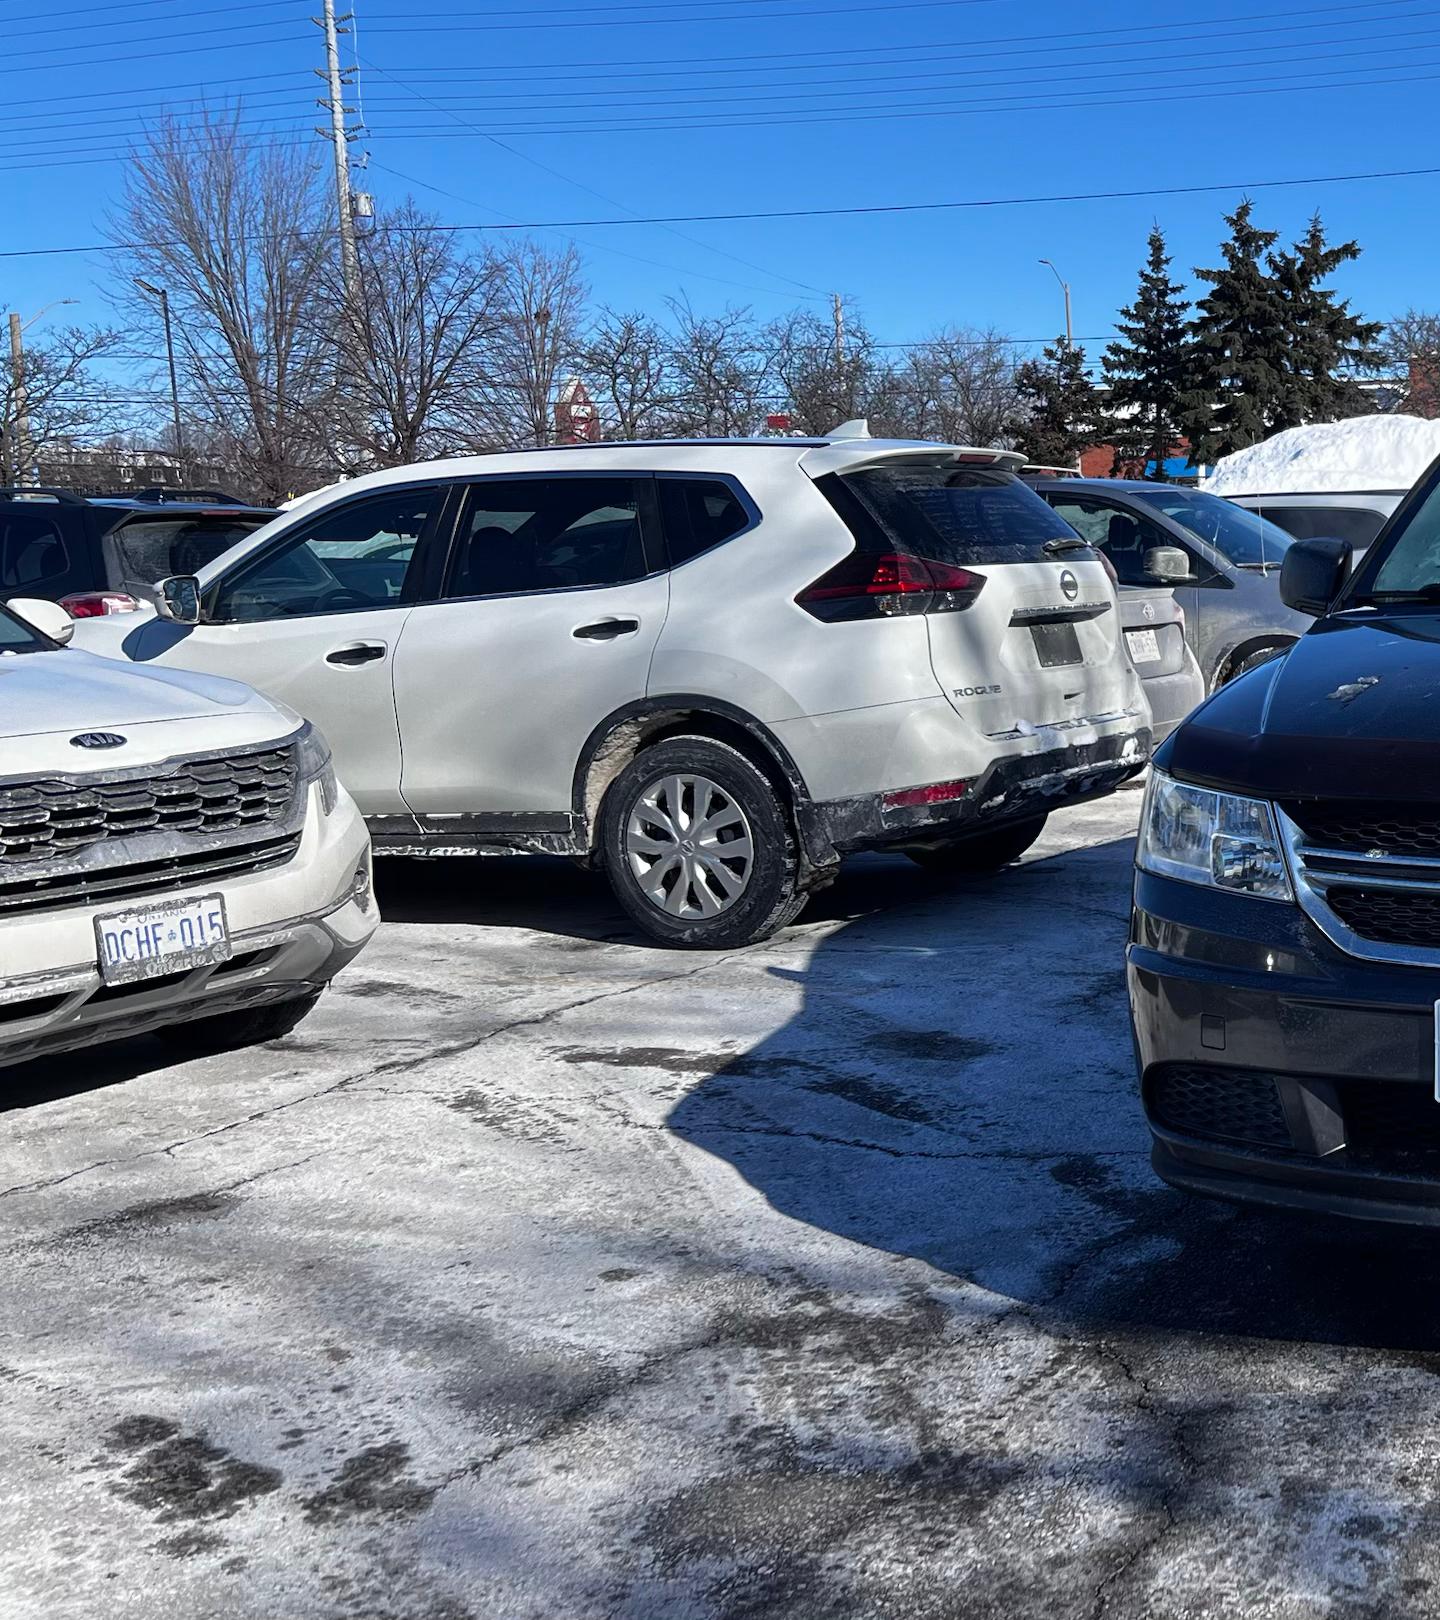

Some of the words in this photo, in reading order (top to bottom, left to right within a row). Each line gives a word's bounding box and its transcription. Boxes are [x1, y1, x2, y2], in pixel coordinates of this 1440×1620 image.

[952, 684, 1002, 698] ROGUE
[104, 922, 164, 965] DCHF
[179, 911, 225, 949] 015
